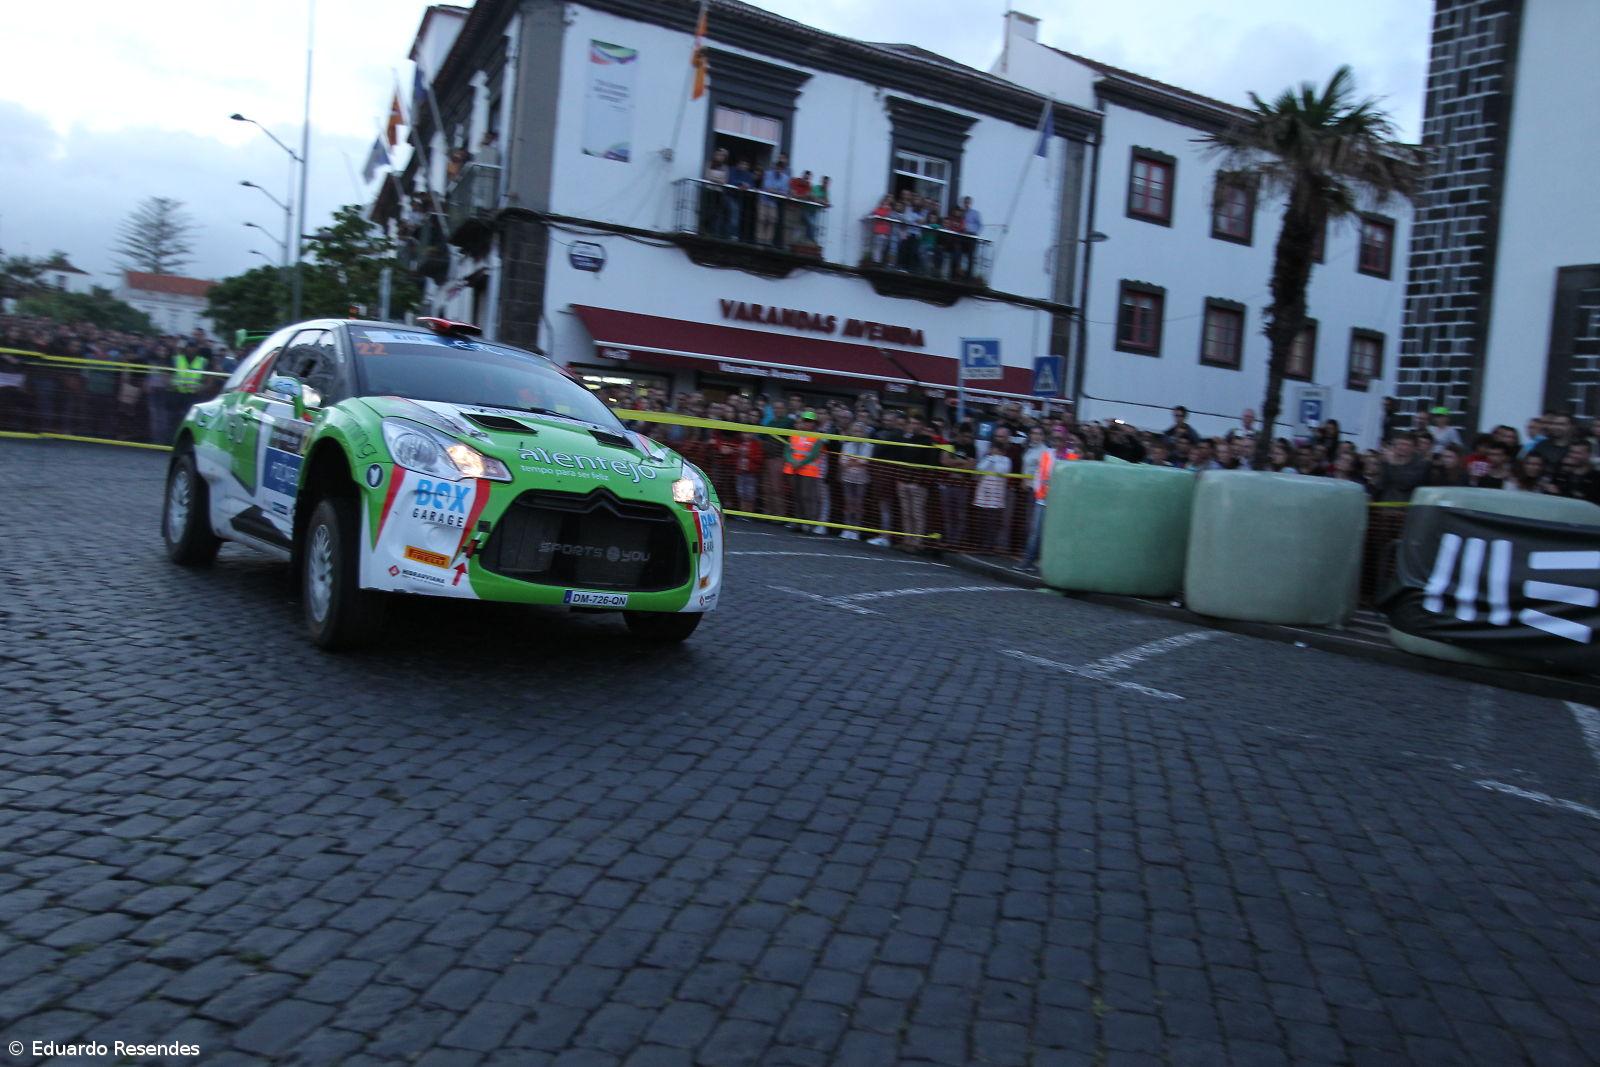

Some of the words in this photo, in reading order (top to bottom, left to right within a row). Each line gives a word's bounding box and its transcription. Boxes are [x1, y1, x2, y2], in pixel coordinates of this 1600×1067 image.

[719, 298, 837, 335] VARANDAS
[842, 318, 927, 347] AVENIDA
[356, 342, 388, 356] 22
[518, 447, 657, 483] alentejo
[556, 469, 577, 478] para
[415, 478, 472, 514] BOX
[412, 508, 465, 528] GARAGE
[538, 542, 604, 558] SPORTS
[620, 549, 651, 562] YOU
[573, 593, 627, 605] DM-726-QN
